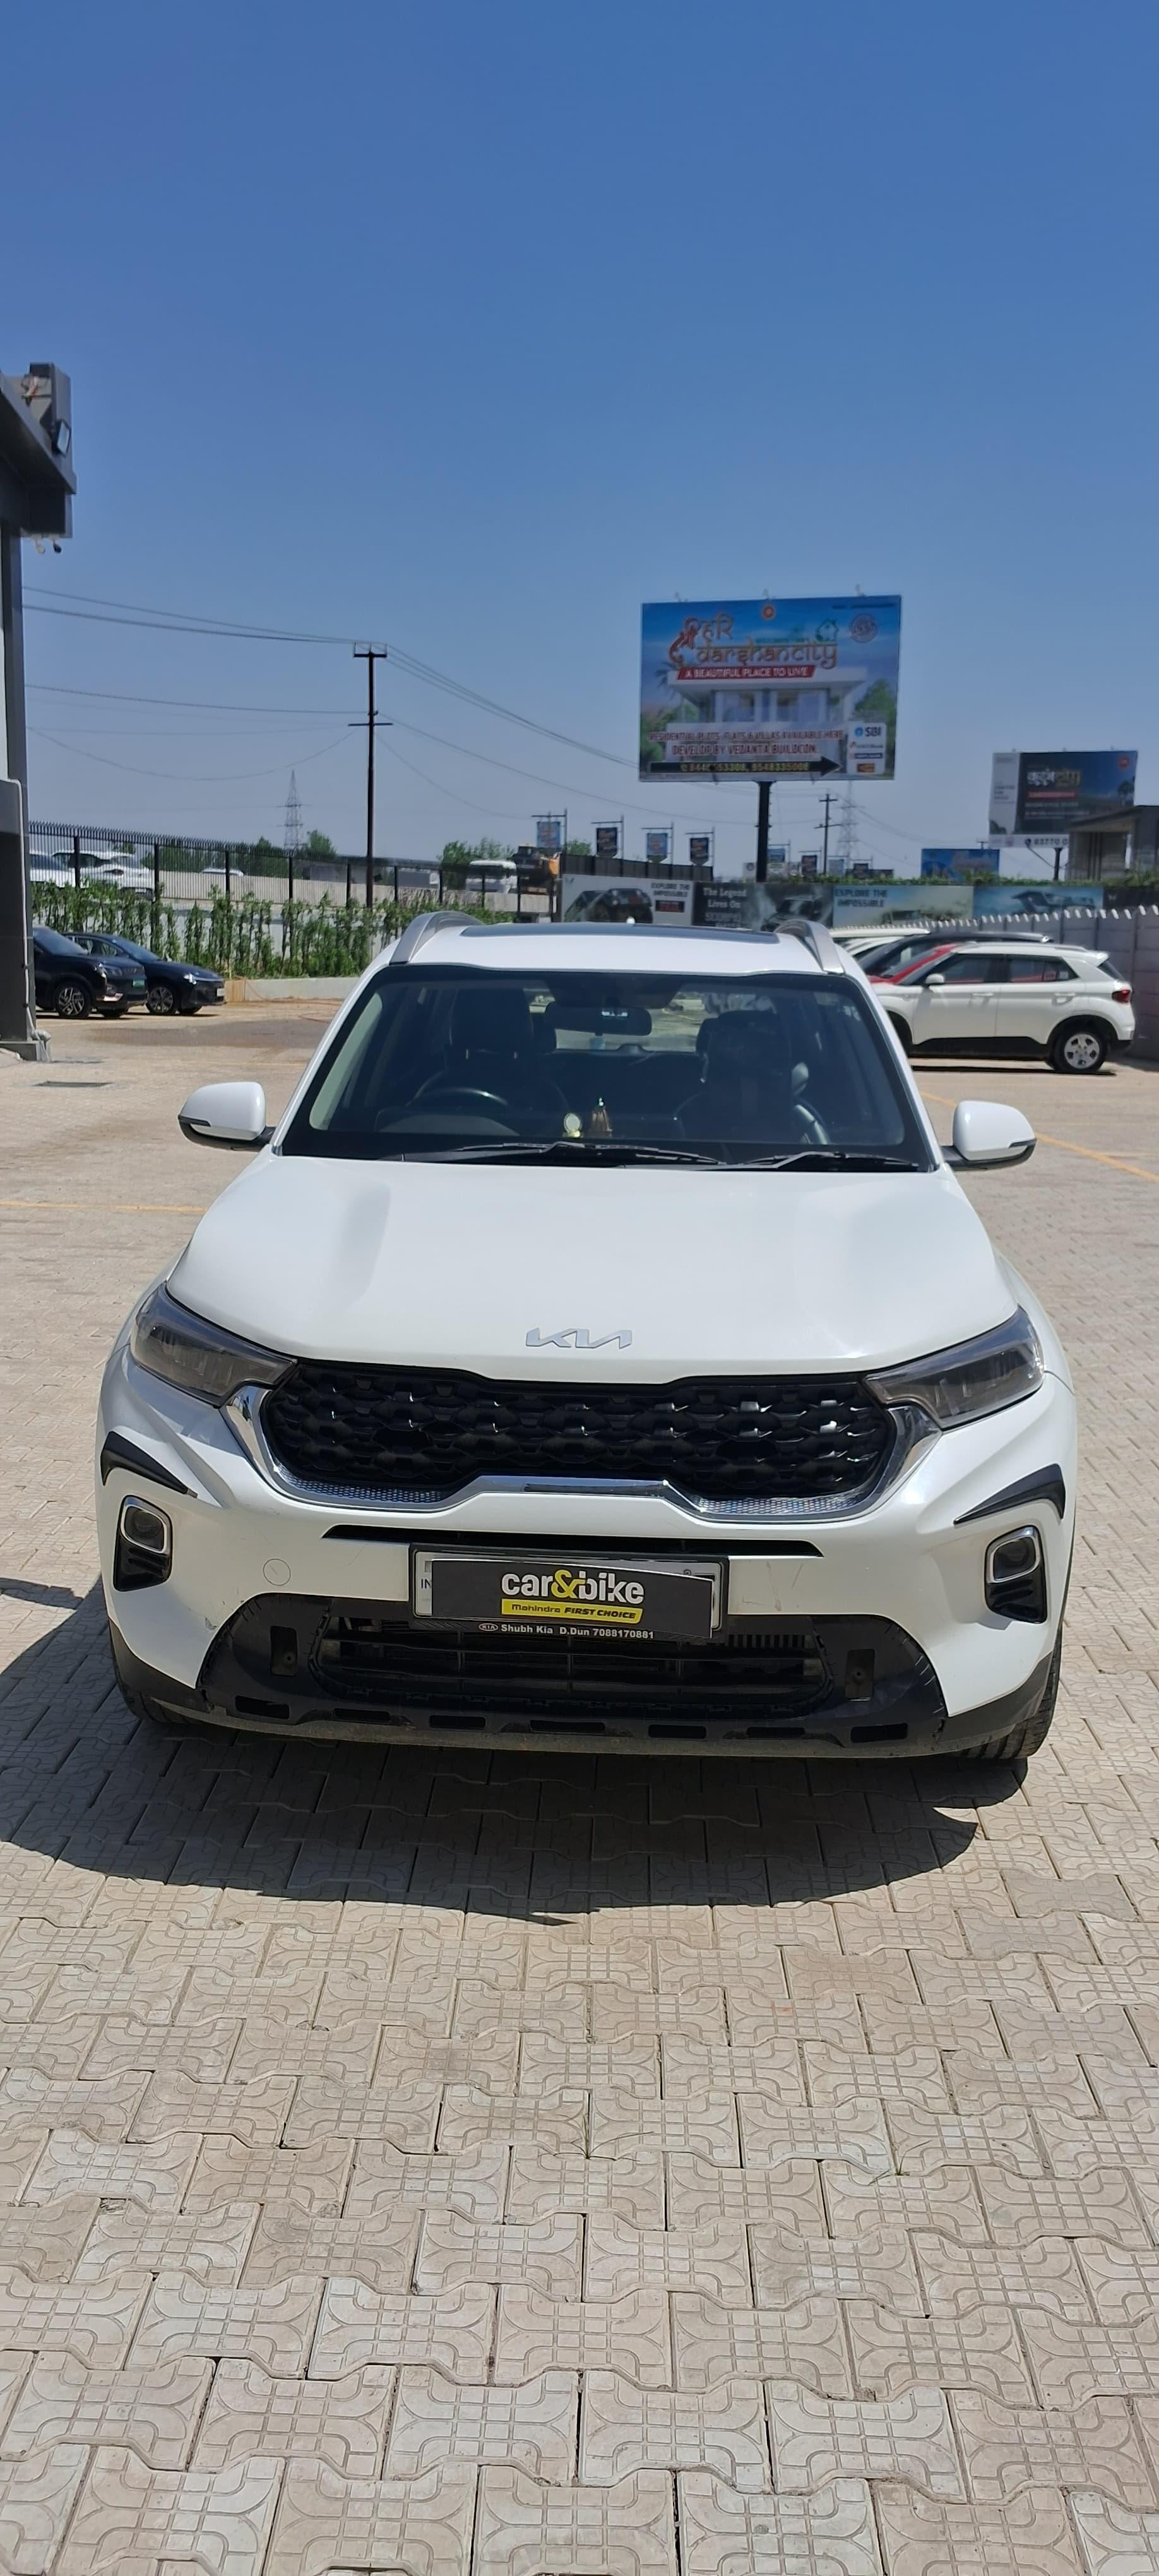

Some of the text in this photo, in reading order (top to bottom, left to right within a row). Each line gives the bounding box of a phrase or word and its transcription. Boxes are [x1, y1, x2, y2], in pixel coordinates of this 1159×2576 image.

[686, 666, 809, 677] A BEAUTIFUL PLACE TO LIVE
[865, 727, 881, 737] SBI
[703, 888, 747, 898] The Legend
[835, 889, 888, 898] EXPLORE THE
[501, 1569, 645, 1604] car&bike
[564, 1607, 596, 1615] FIRST
[597, 1609, 636, 1619] CHOICE
[501, 1624, 533, 1634] Shubh
[536, 1625, 553, 1635] Kia
[559, 1626, 590, 1636] D.Dun
[593, 1628, 655, 1639] 7088170881
